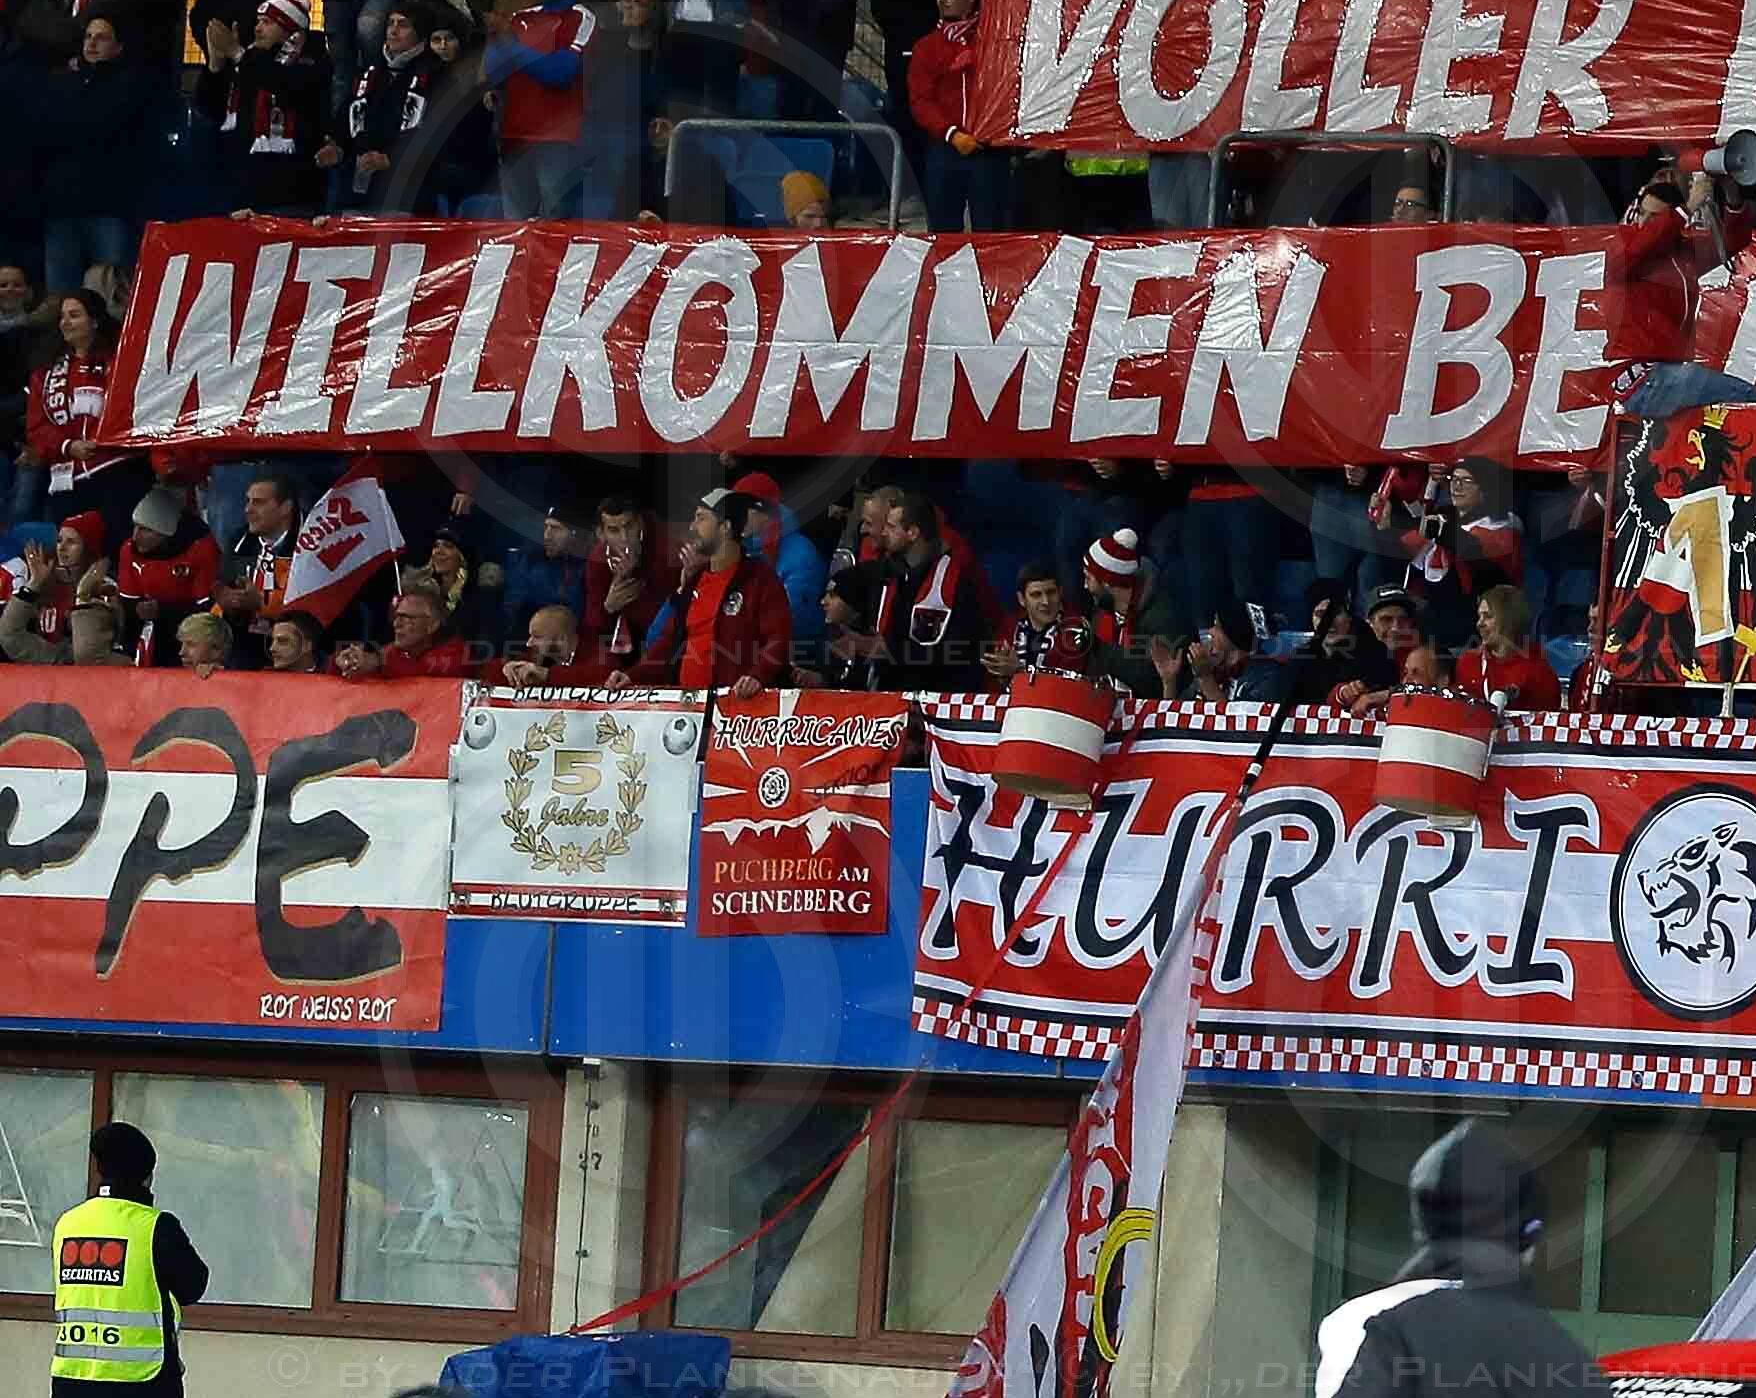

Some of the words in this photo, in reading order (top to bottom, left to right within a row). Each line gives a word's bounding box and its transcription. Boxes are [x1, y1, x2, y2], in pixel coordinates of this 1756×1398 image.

[130, 232, 1328, 445] WILLKOMMEN
[713, 714, 906, 750] HURRICANES
[551, 749, 602, 795] 5
[535, 796, 610, 834] Jahre
[713, 857, 832, 884] PUCHBERG
[837, 867, 870, 883] AM
[489, 892, 642, 914] BLUTGRUPPE
[711, 889, 872, 915] SCHNEEBERG
[259, 995, 298, 1020] ROT
[301, 997, 352, 1021] WEISS
[358, 998, 396, 1022] ROT
[61, 1267, 120, 1283] SECURITAS
